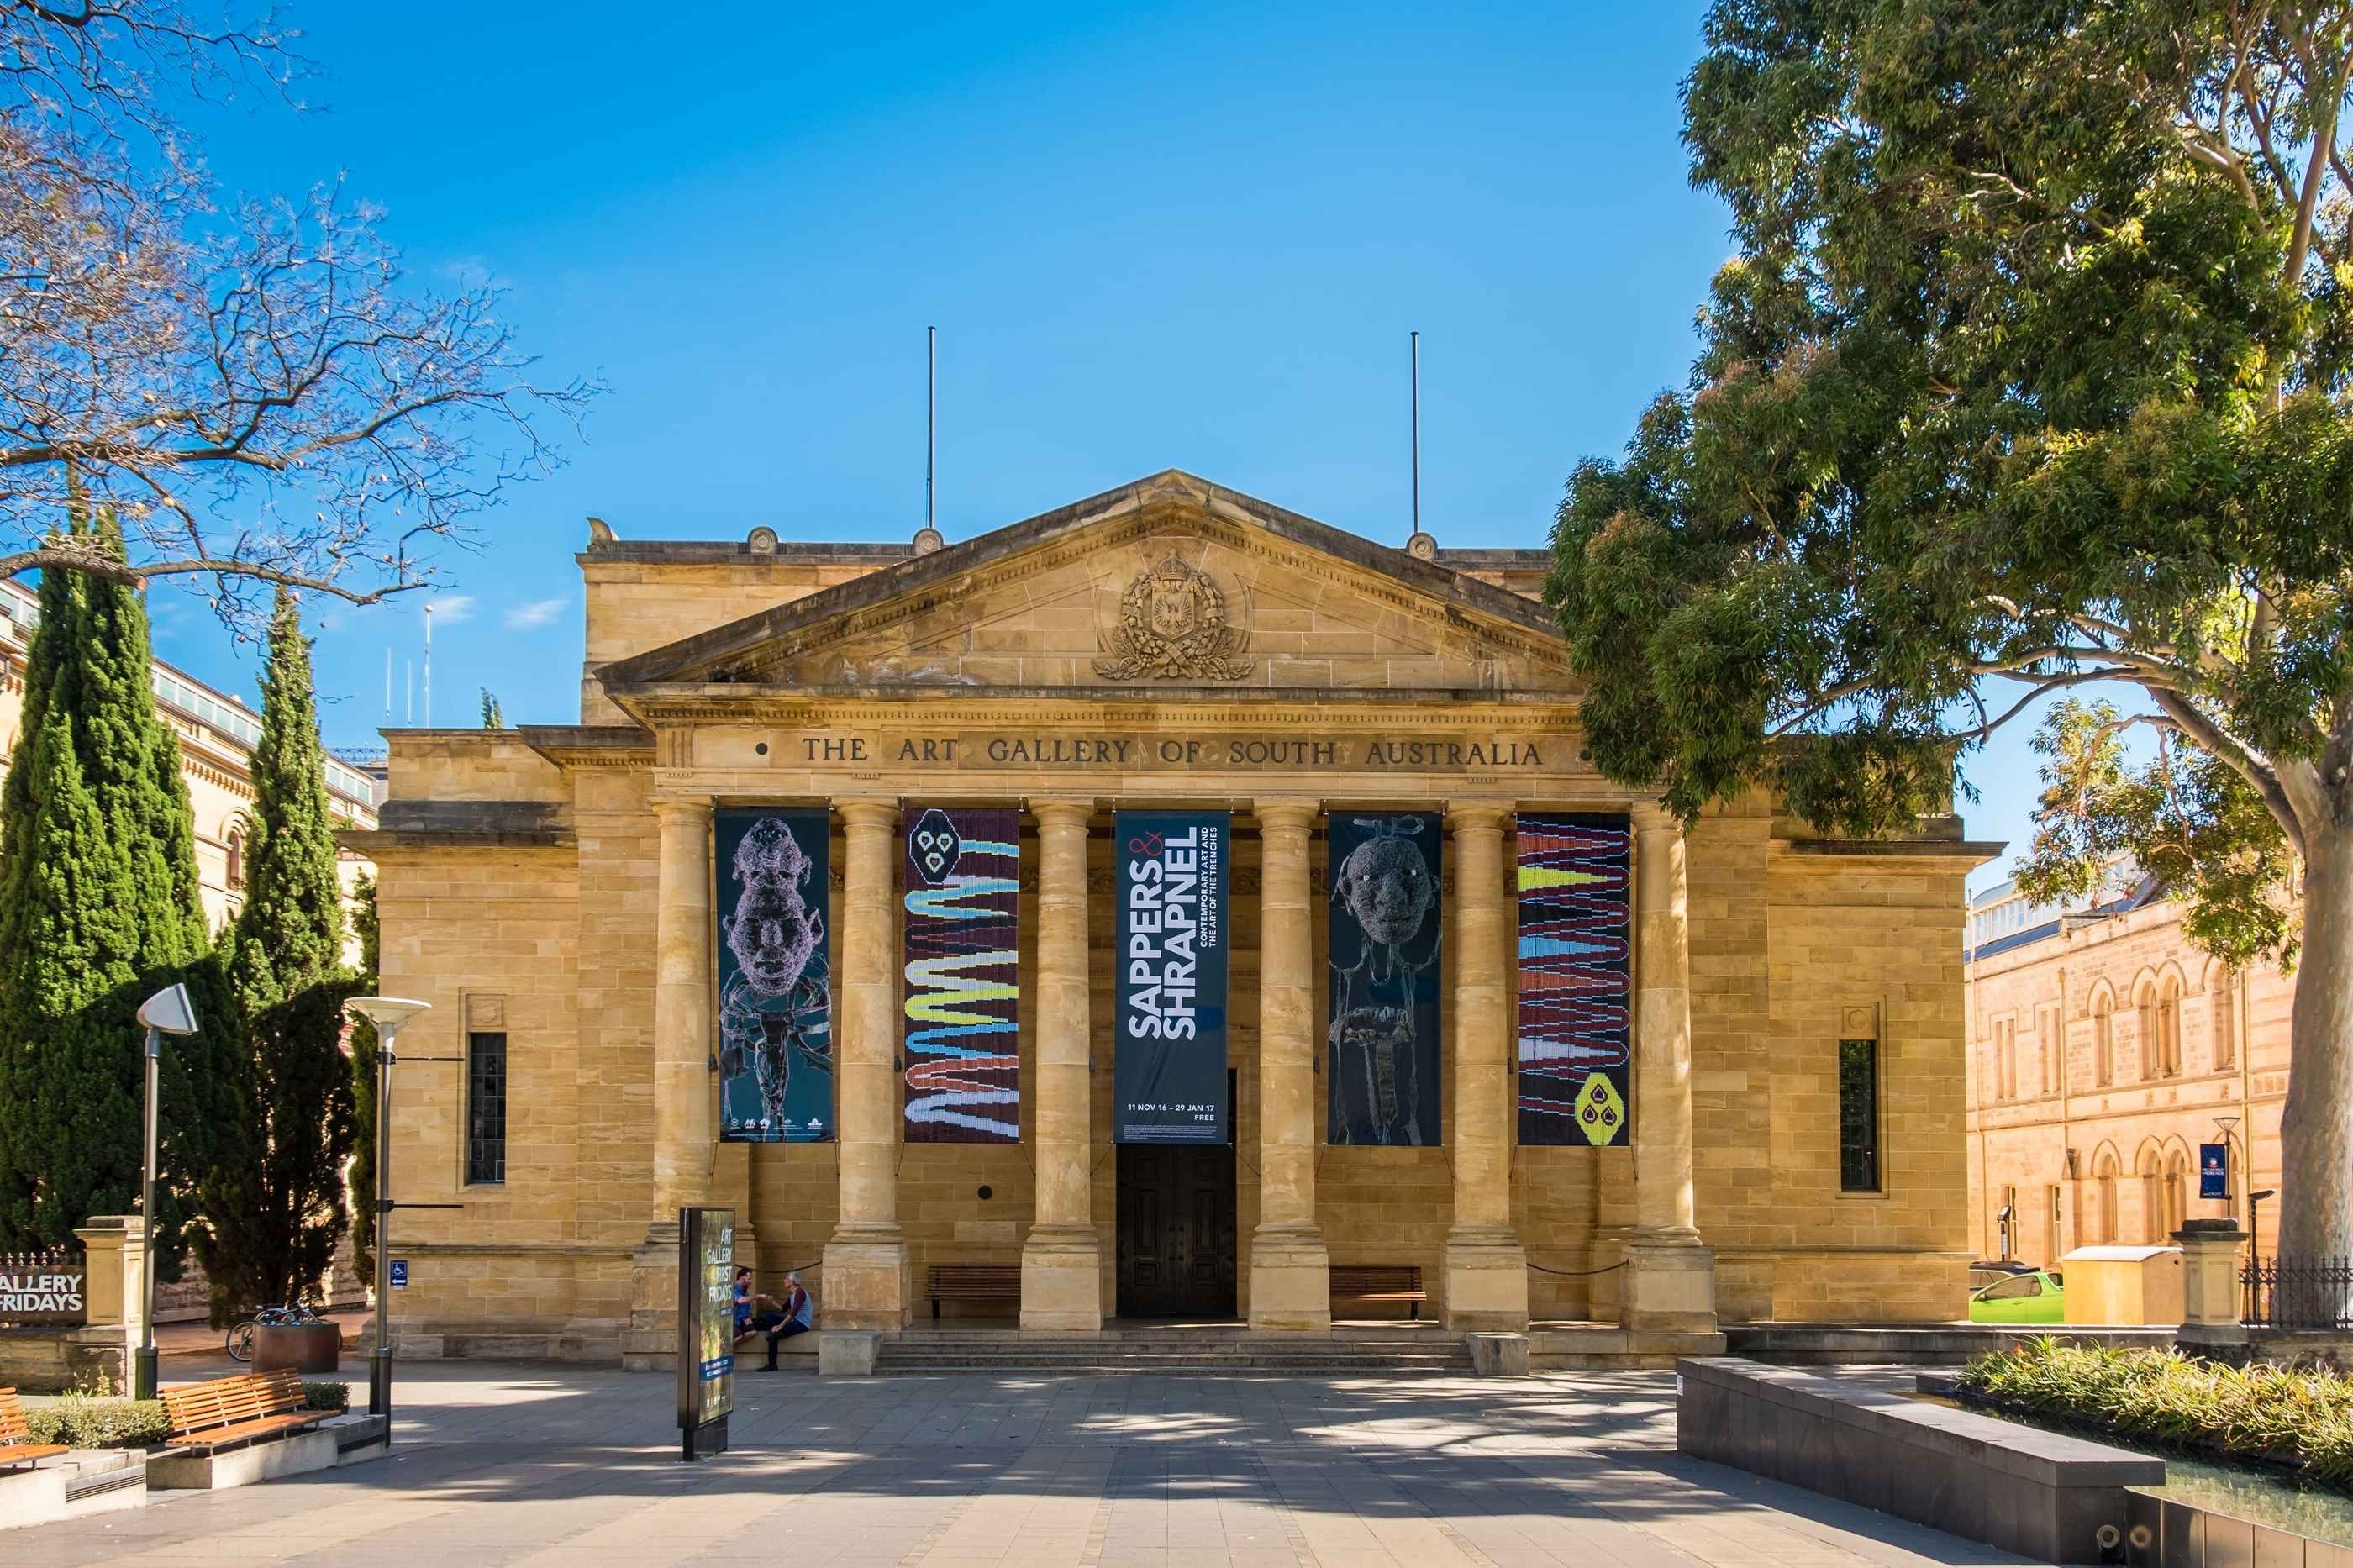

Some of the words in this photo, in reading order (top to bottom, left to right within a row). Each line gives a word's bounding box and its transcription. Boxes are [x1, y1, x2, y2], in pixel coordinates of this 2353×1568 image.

[803, 738, 868, 760] THE
[897, 739, 958, 761] ART
[987, 739, 1131, 762] GALLERY
[1160, 739, 1201, 764] OF
[1229, 741, 1334, 765] SOUTH
[1365, 742, 1543, 766] AUSTRALIA
[1129, 831, 1163, 856] &
[1209, 826, 1218, 876] TRENCHES
[1200, 870, 1208, 948] CONTEMPORARY
[1209, 897, 1217, 909] OF
[1162, 826, 1198, 1041] SHRAPNEL
[1208, 929, 1217, 948] THE
[1129, 859, 1163, 1039] SAPPERS
[720, 1229, 733, 1244] ART
[706, 1248, 733, 1265] GALLERY
[716, 1266, 733, 1282] FIRST
[708, 1285, 733, 1303] FRIDAYS
